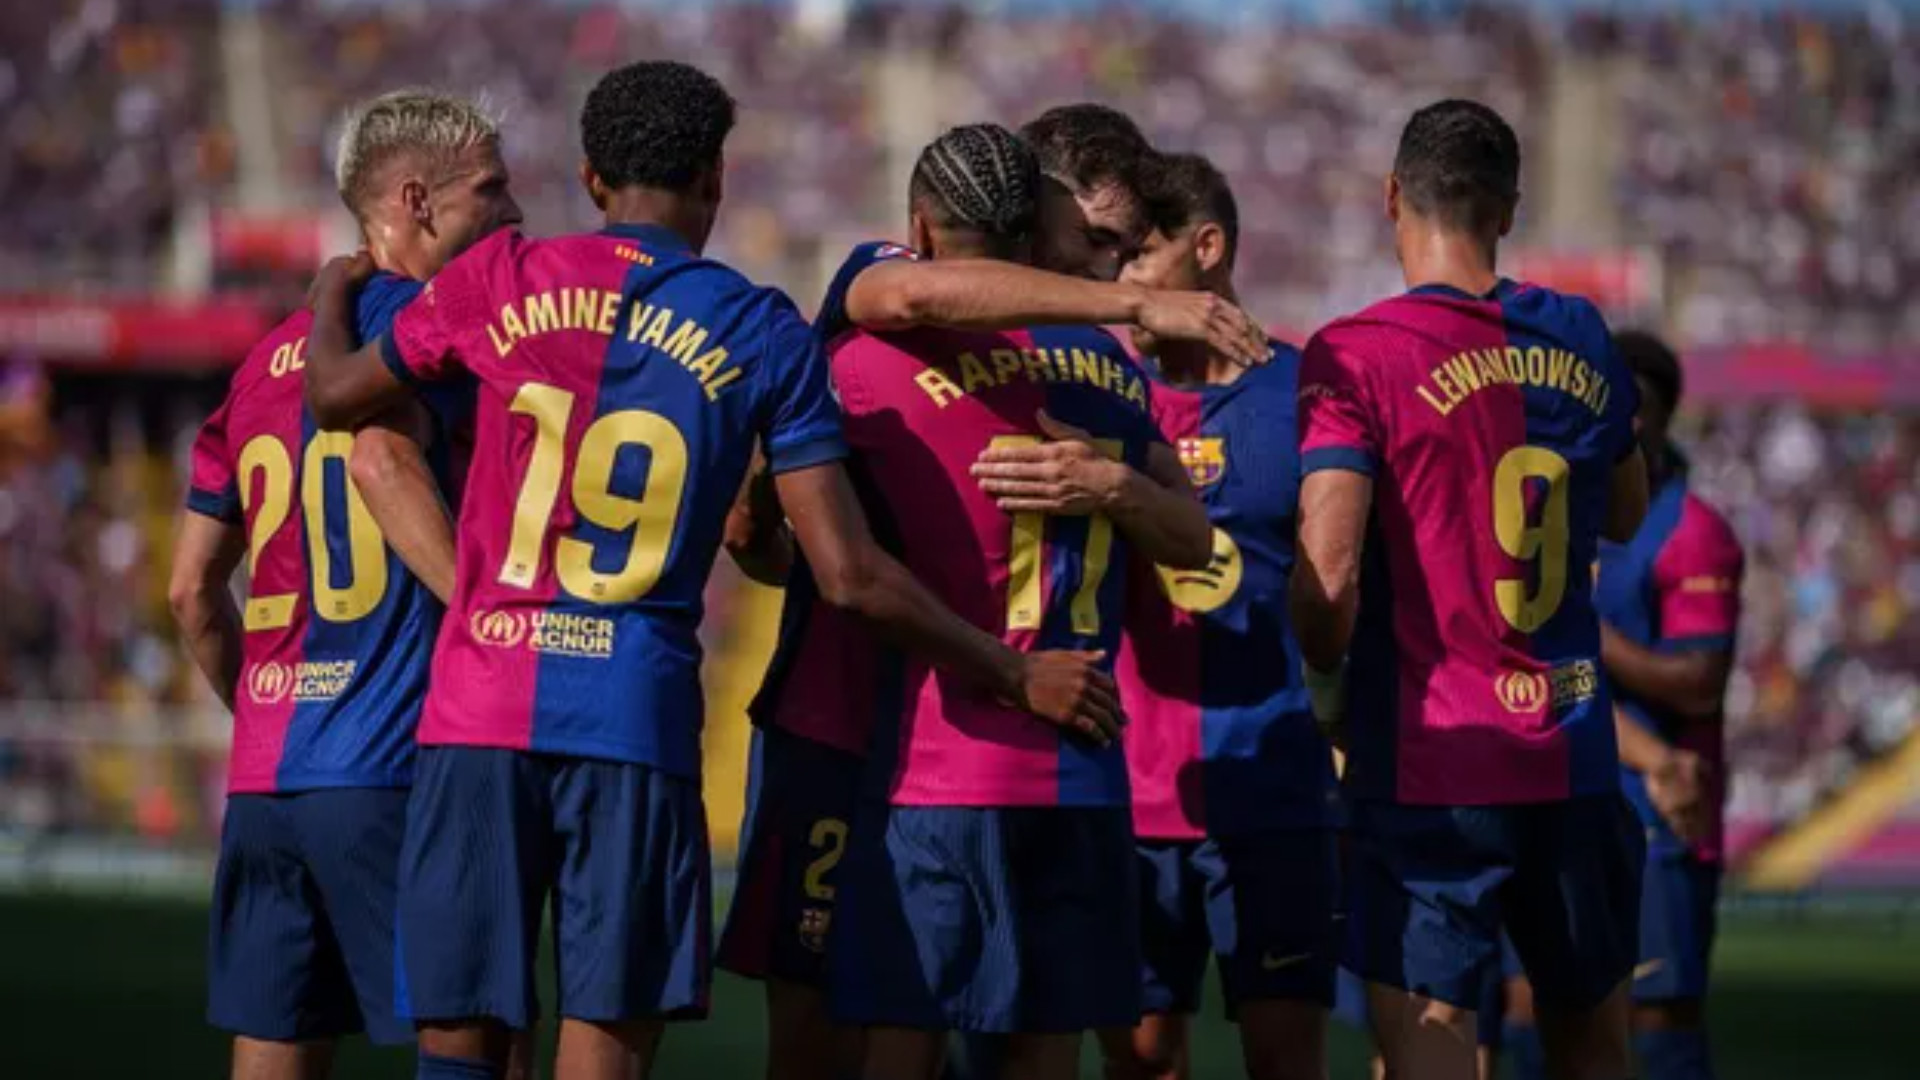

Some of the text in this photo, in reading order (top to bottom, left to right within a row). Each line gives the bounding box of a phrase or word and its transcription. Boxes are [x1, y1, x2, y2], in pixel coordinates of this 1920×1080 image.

[269, 337, 306, 378] OL
[486, 287, 743, 402] LAMINE YAMAL
[914, 348, 1146, 412] RAPHINHA
[1416, 345, 1611, 416] LEWANDOWSKI
[497, 382, 688, 604] 19
[237, 430, 388, 631] 20
[1494, 445, 1570, 633] 9
[529, 631, 612, 652] ACNUR
[531, 611, 613, 636] UNHCR
